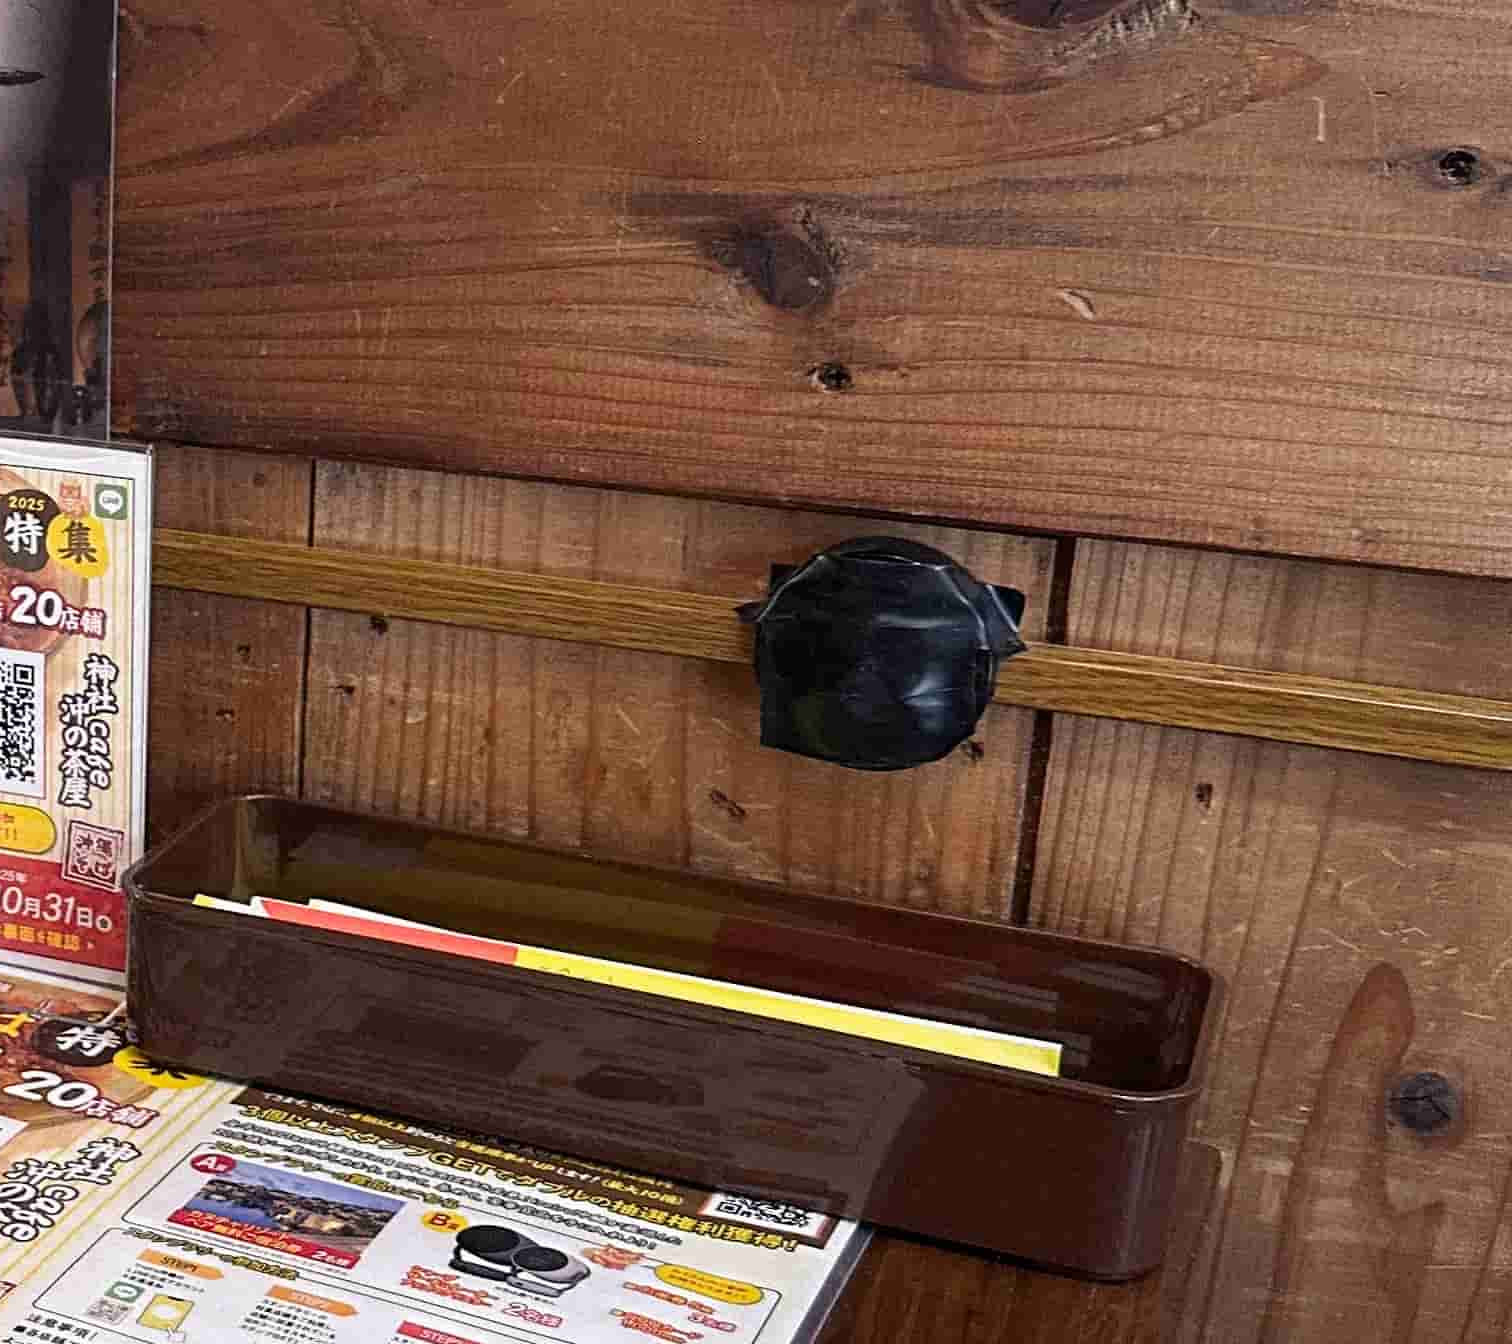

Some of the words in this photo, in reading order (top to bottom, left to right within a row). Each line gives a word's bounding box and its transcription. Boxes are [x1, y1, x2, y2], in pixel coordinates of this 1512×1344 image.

[7, 494, 45, 512] 2025
[59, 694, 92, 808] 沖の茶屋
